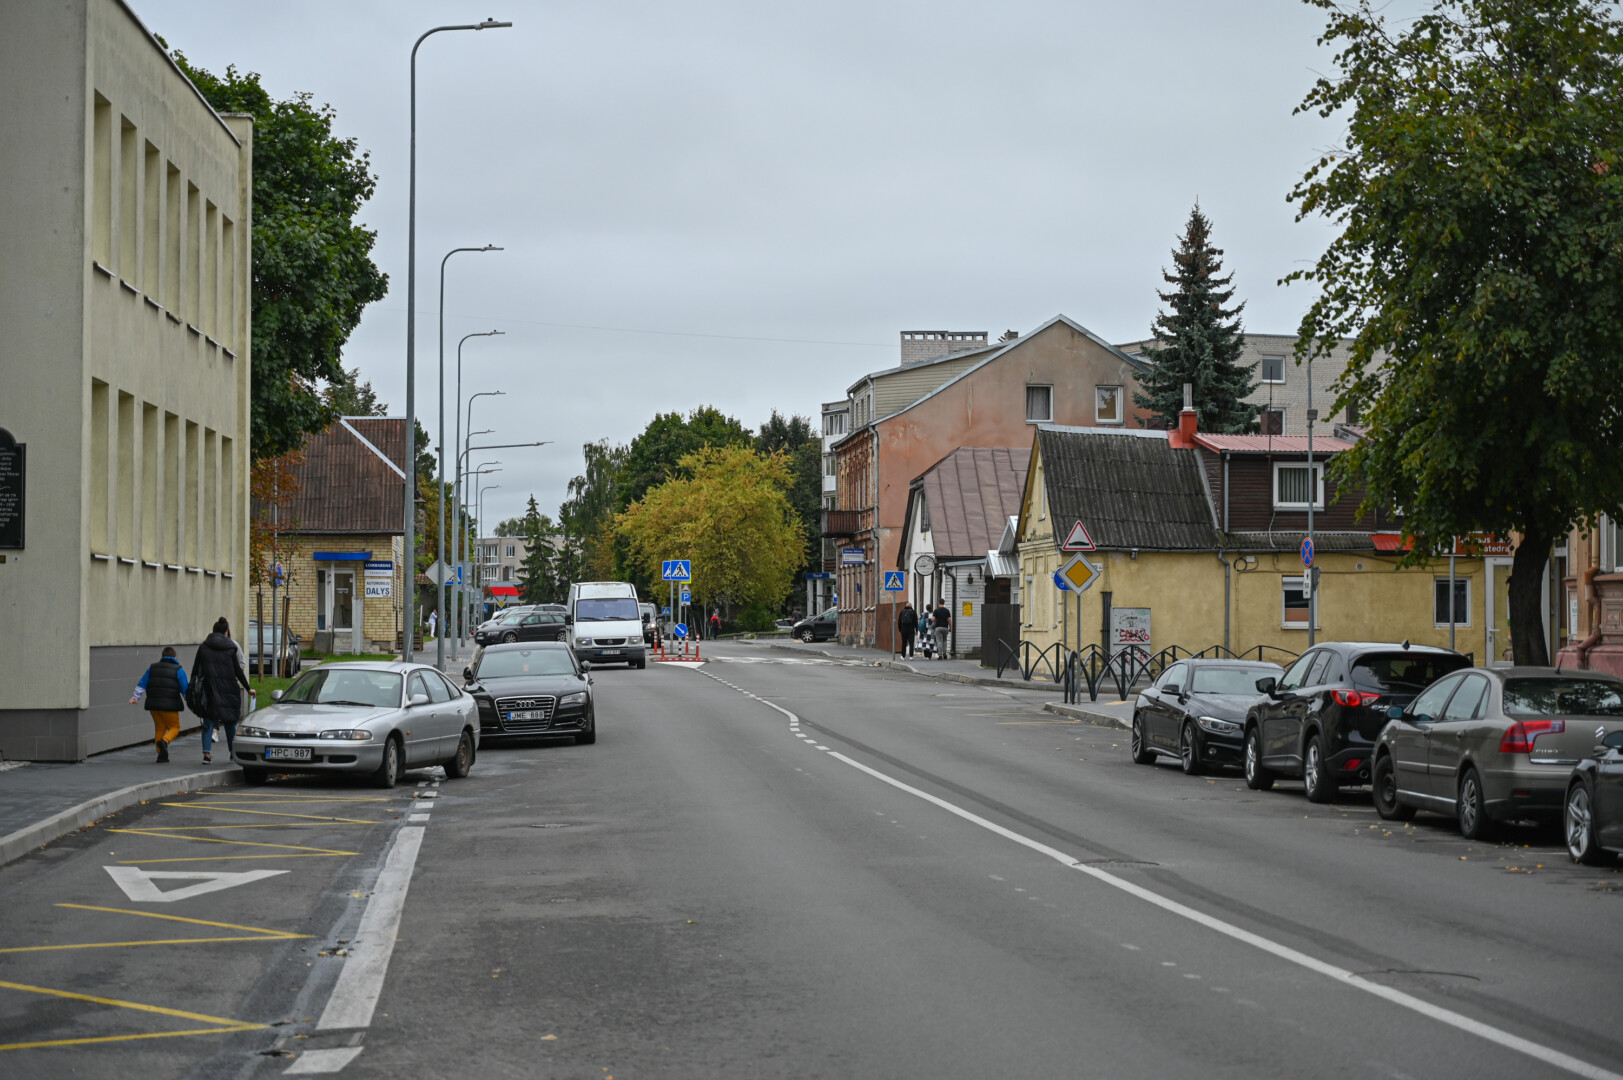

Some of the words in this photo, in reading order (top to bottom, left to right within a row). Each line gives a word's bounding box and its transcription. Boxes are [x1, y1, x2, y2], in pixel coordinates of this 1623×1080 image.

[366, 587, 390, 595] DALYS
[683, 593, 690, 601] P
[271, 748, 288, 757] HPC
[294, 749, 310, 758] 987
